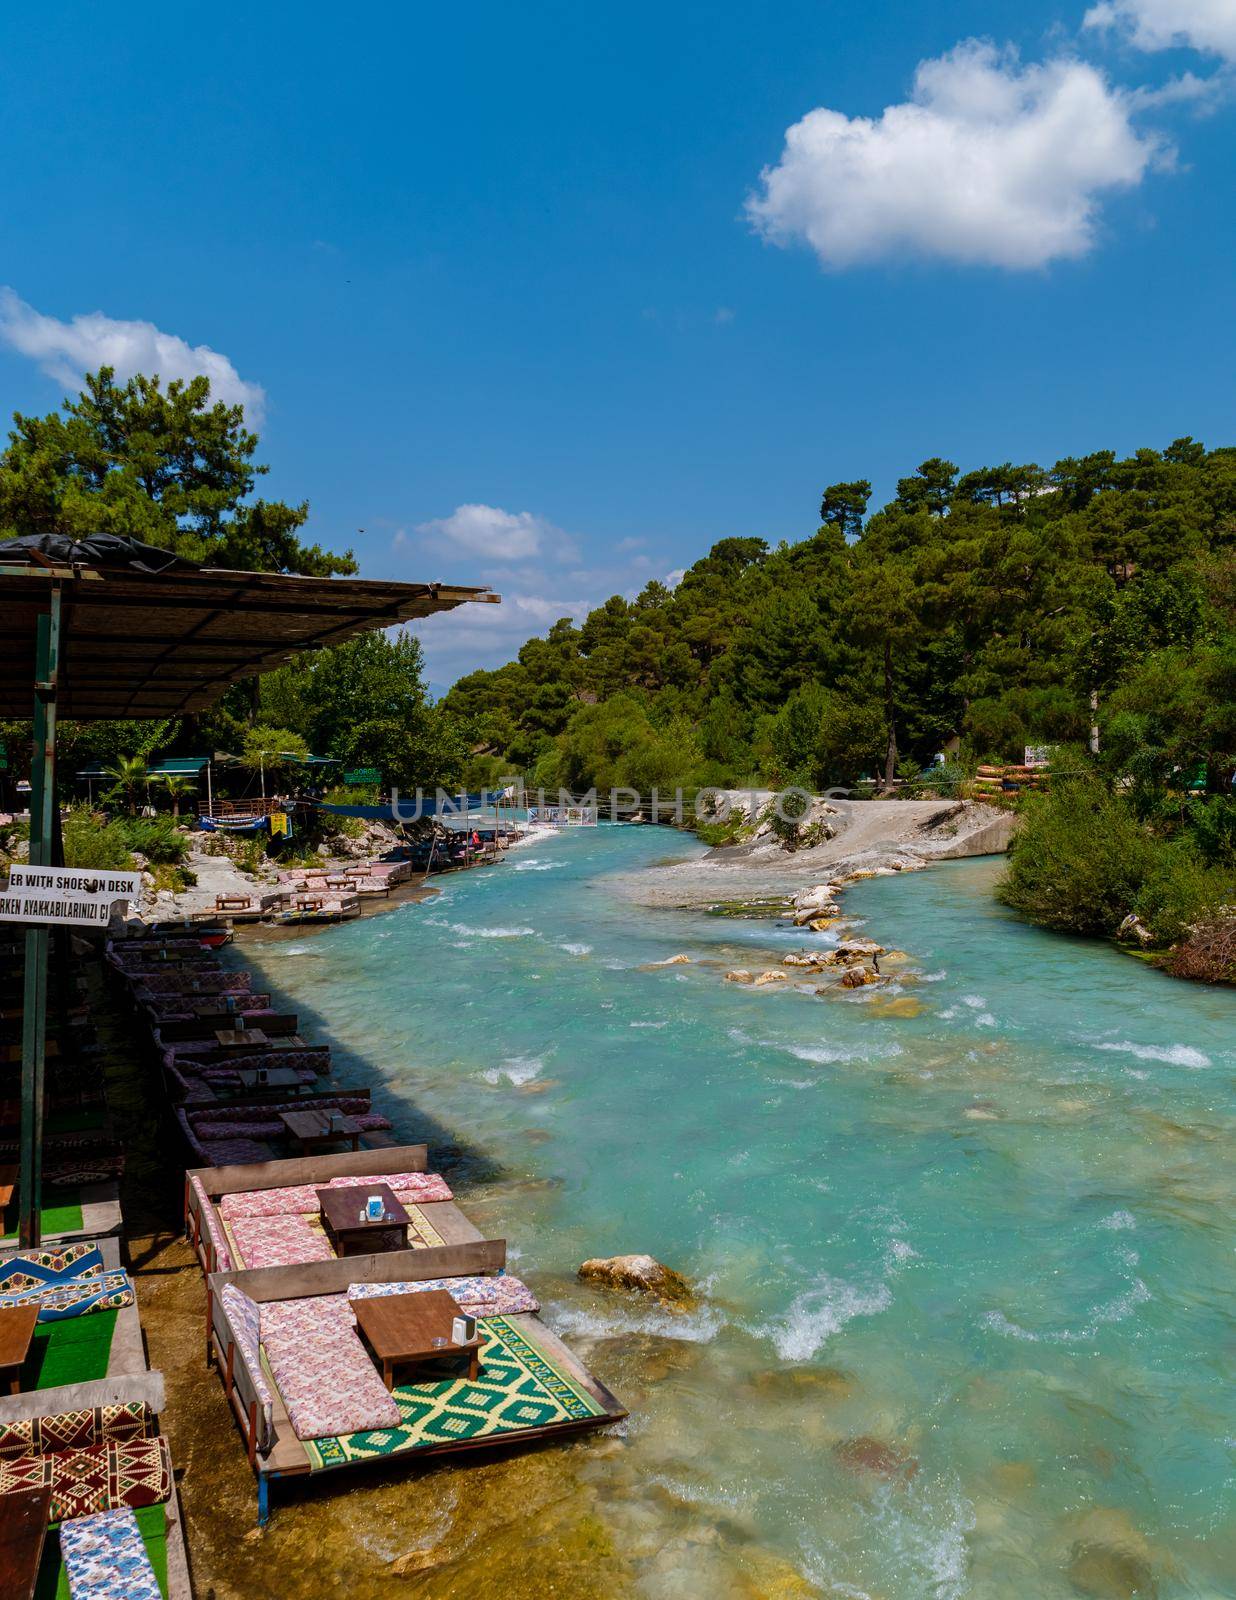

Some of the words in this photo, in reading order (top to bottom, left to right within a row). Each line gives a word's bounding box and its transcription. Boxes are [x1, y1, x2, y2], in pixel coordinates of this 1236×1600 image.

[26, 875, 53, 888] WITH
[56, 877, 90, 890] SHOES
[90, 879, 106, 892] ON
[108, 880, 134, 892] DESK
[23, 900, 97, 919] AYAKKABILARINIZI
